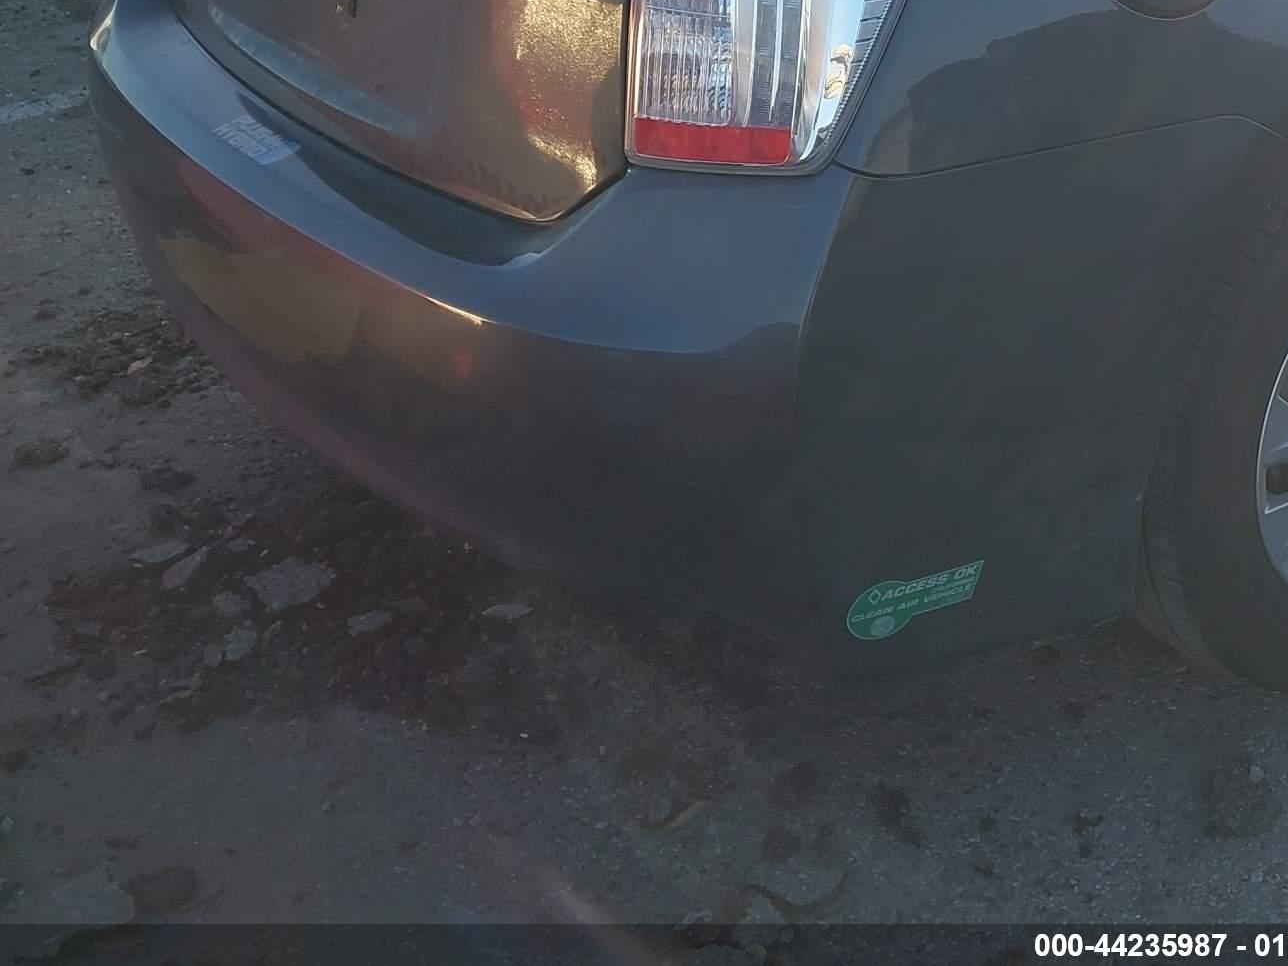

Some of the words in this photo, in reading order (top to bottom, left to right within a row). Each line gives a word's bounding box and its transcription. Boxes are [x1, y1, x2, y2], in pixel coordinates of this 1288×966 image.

[881, 574, 949, 602] ACCESS
[954, 565, 977, 579] OK
[851, 606, 895, 623] CLEAN
[897, 599, 919, 610] AIR
